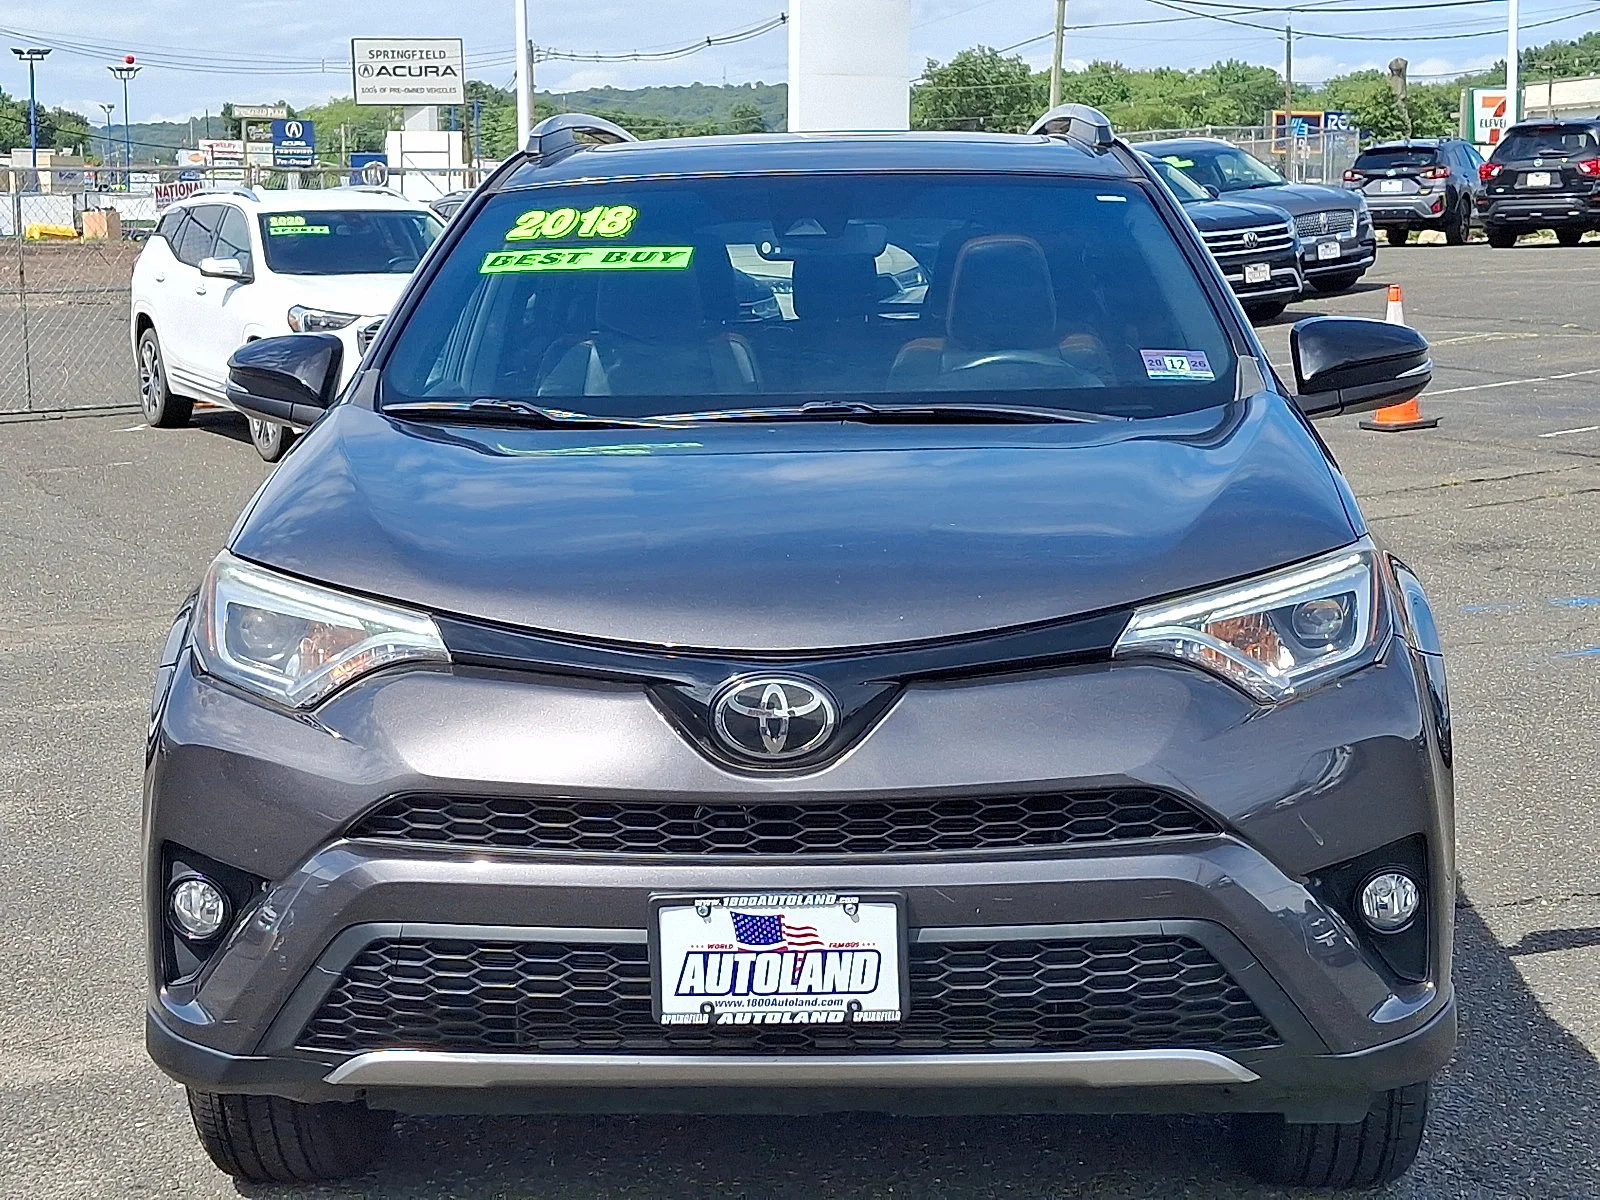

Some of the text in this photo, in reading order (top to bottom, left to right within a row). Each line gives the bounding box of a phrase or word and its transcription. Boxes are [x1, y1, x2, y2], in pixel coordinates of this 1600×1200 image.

[368, 49, 446, 60] SPRINGFIELD
[375, 65, 458, 77] ACURA
[505, 204, 638, 241] 2018
[486, 251, 688, 267] BEST BUY
[1147, 358, 1207, 370] 20 12 26
[674, 950, 882, 997] AUTOLAND
[714, 998, 844, 1008] www.1800Autoland.com
[716, 1010, 846, 1025] AUTOLAND
